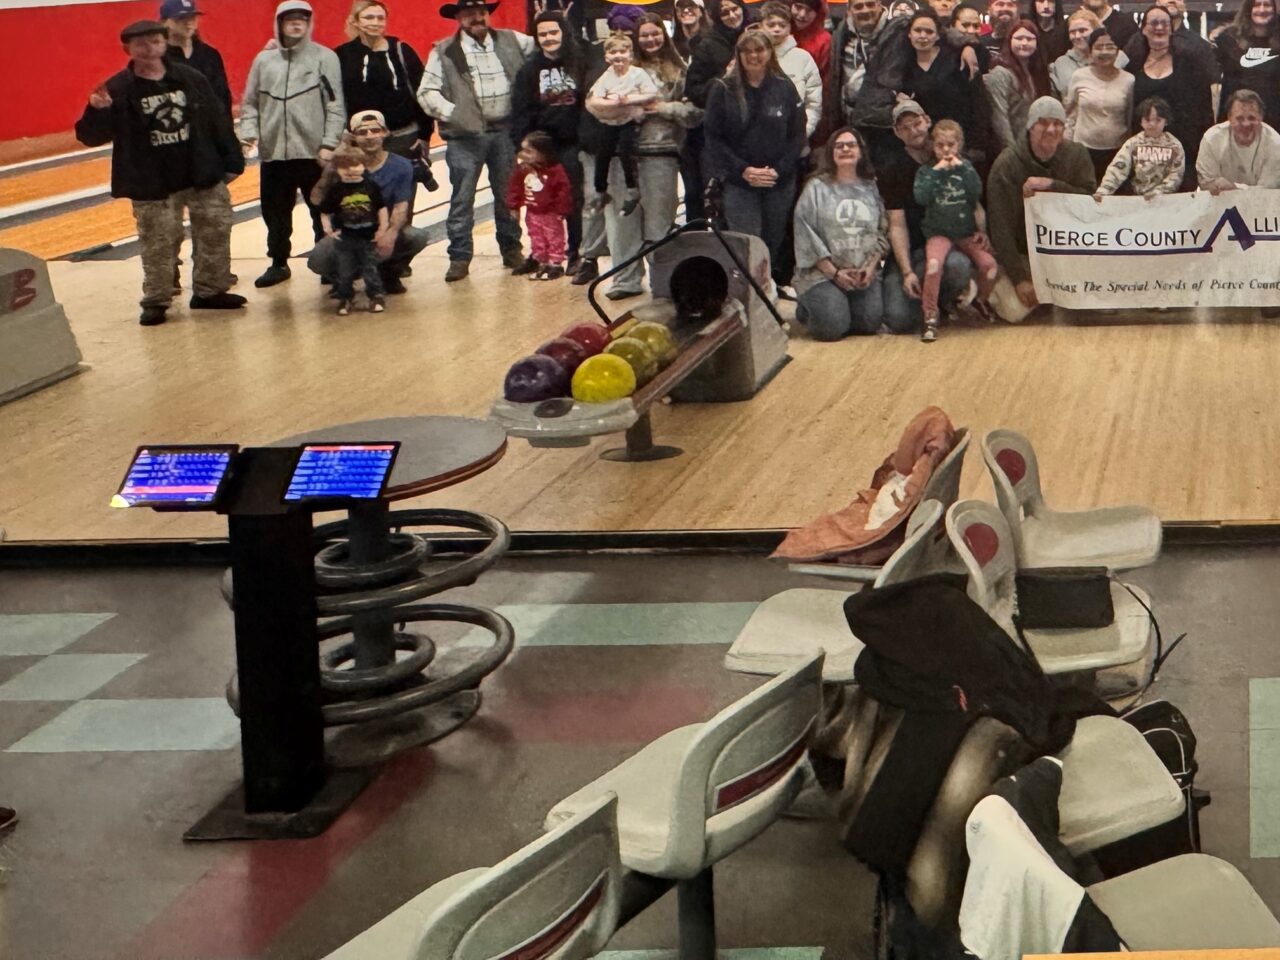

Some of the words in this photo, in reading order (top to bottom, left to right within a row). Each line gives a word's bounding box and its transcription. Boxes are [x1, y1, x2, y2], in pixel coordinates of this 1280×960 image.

[1216, 3, 1223, 11] 7
[1036, 224, 1109, 247] PIERCE
[1115, 228, 1201, 247] COUNTY
[1084, 281, 1102, 292] The
[1107, 281, 1149, 293] Special
[1153, 280, 1187, 291] Needs
[1191, 279, 1205, 290] of
[1210, 279, 1245, 290] Pierce
